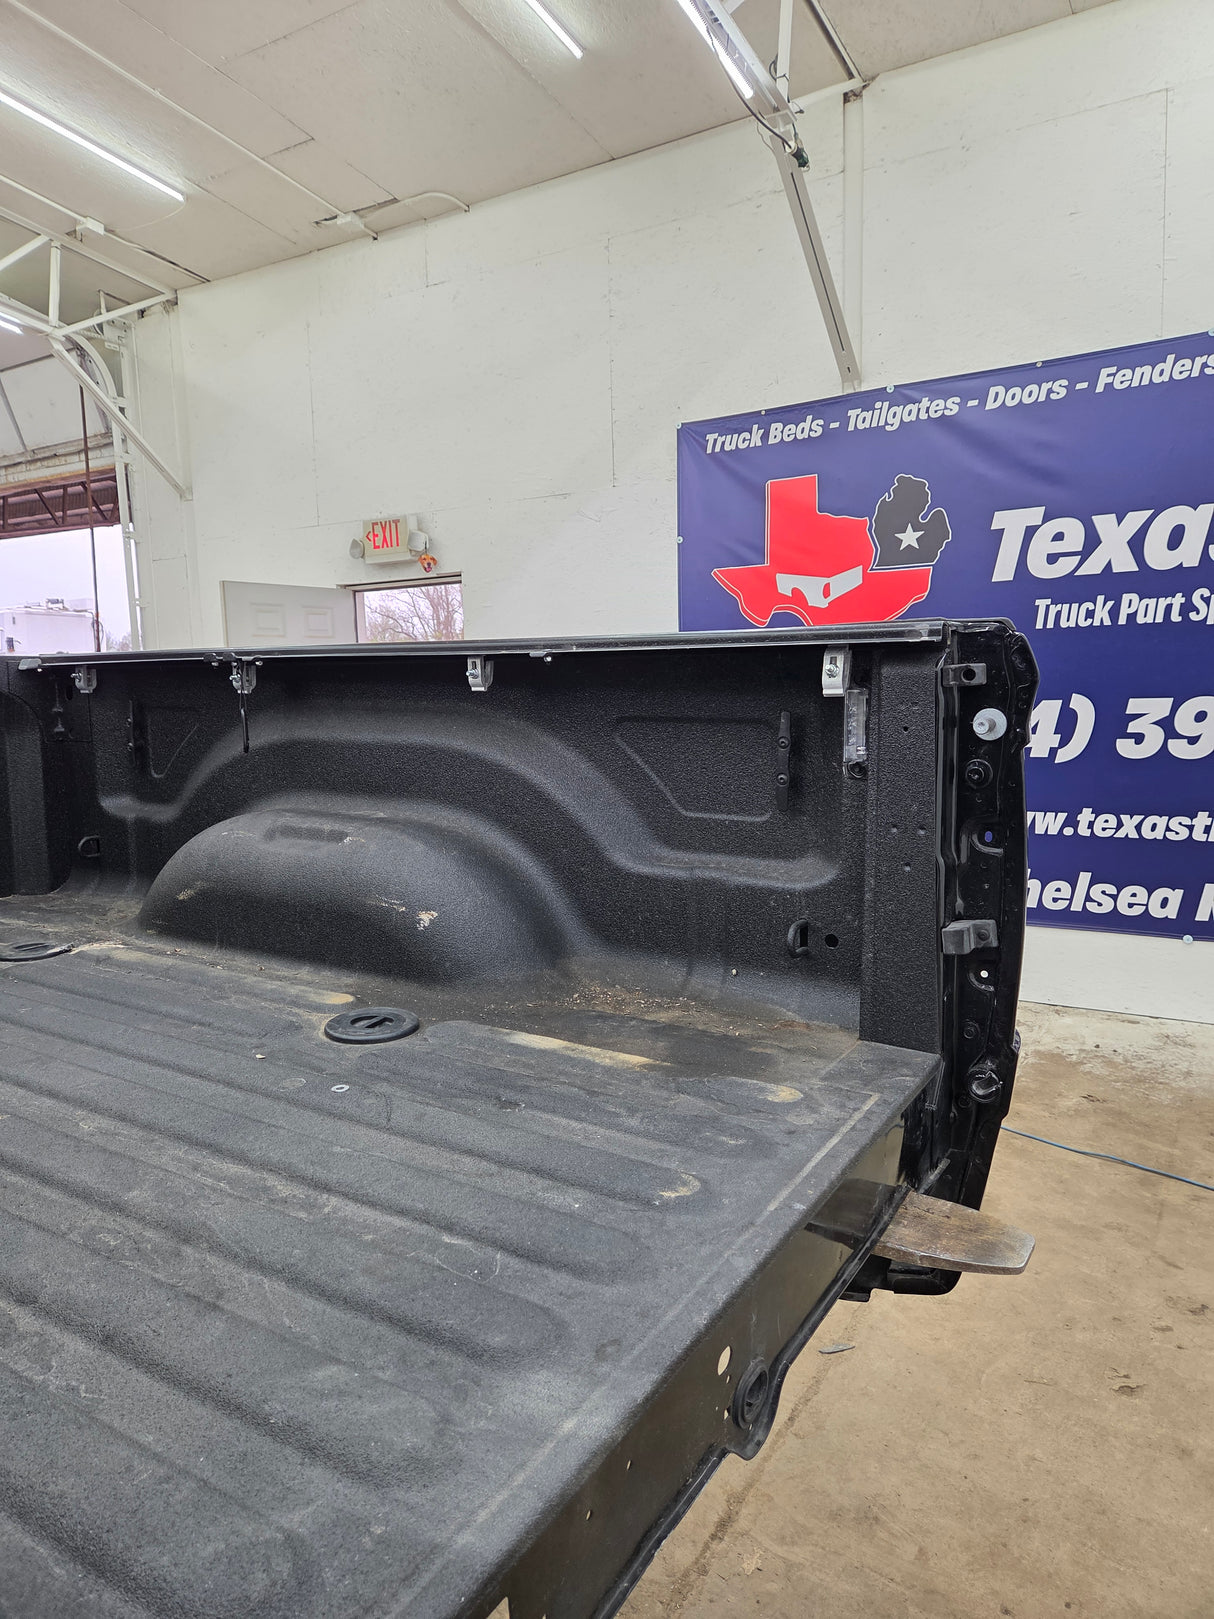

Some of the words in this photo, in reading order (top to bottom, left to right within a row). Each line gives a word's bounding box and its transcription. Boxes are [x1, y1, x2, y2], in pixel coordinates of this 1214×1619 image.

[705, 424, 765, 454] Truck
[767, 415, 825, 447] Beds
[847, 396, 960, 432] Tailgates
[984, 378, 1069, 411] Doors
[1094, 353, 1214, 394] Fenders
[371, 518, 400, 550] EXIT
[990, 503, 1214, 583] Texa
[1034, 594, 1115, 630] Truck
[1117, 591, 1186, 625] Part
[1023, 693, 1096, 764] 4)
[1115, 695, 1214, 760] 39
[1026, 868, 1184, 919] helsea
